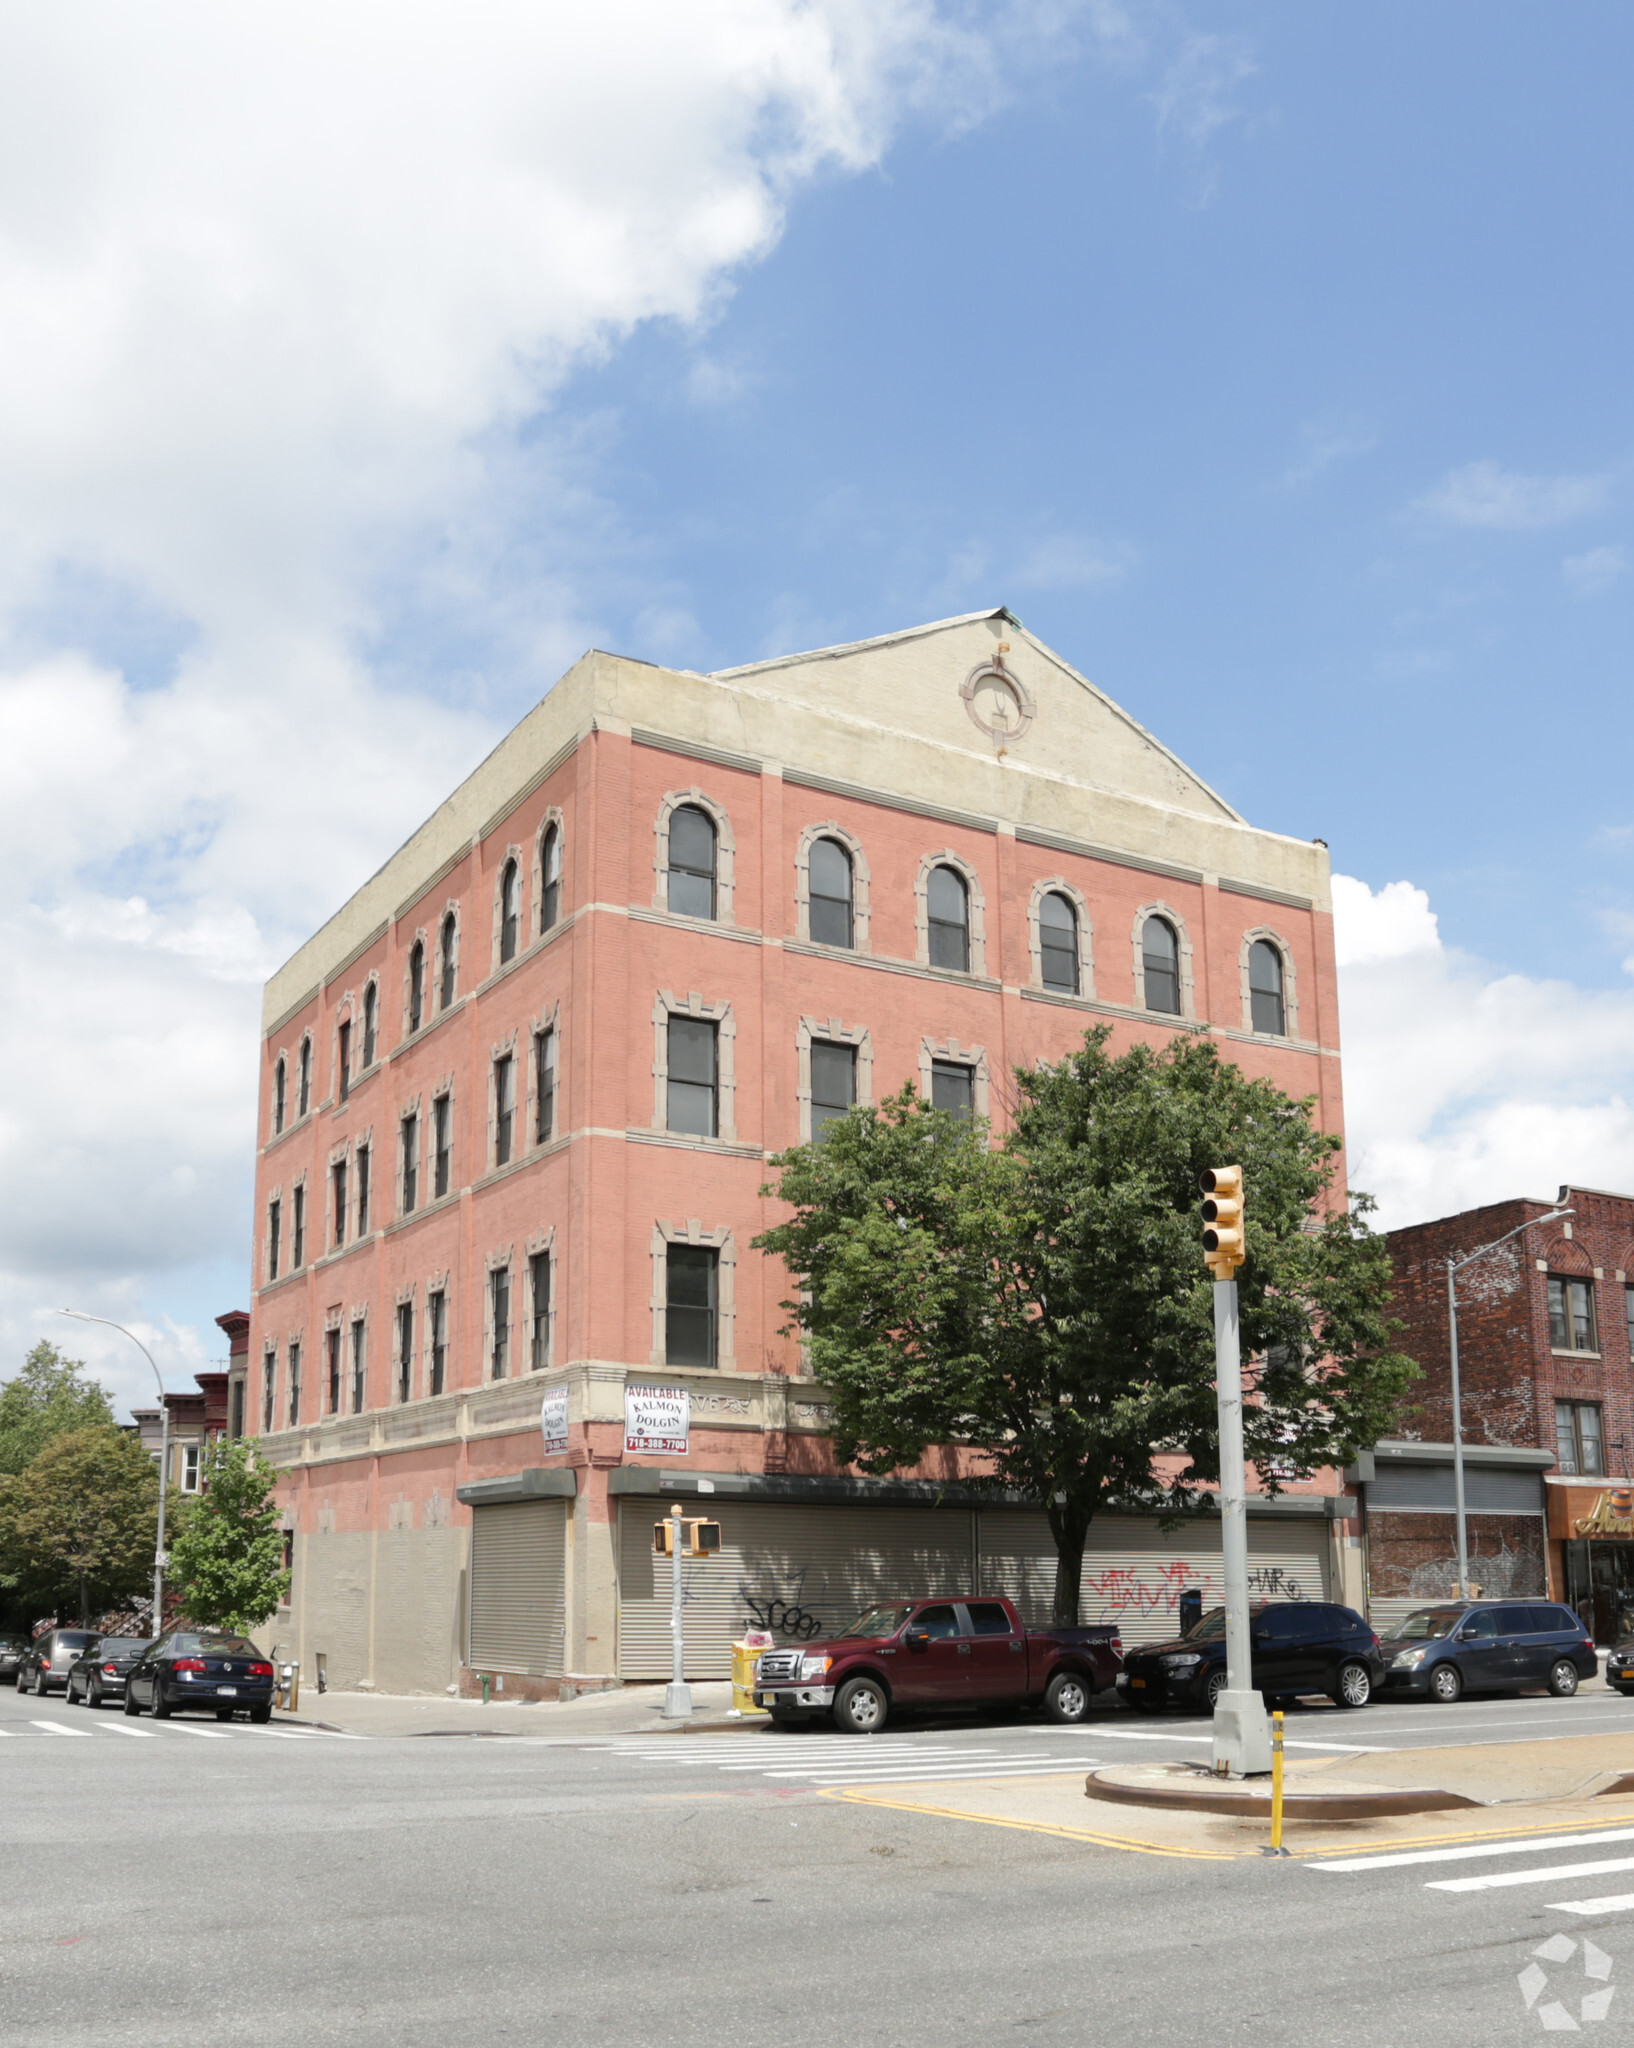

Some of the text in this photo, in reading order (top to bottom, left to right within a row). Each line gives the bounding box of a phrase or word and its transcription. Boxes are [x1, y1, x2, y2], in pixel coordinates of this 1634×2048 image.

[628, 1386, 686, 1400] AVAILABLE
[633, 1400, 683, 1415] KALMON
[689, 1395, 719, 1412] VE
[635, 1414, 680, 1428] DOLGIN
[628, 1437, 686, 1450] 718-388-7700
